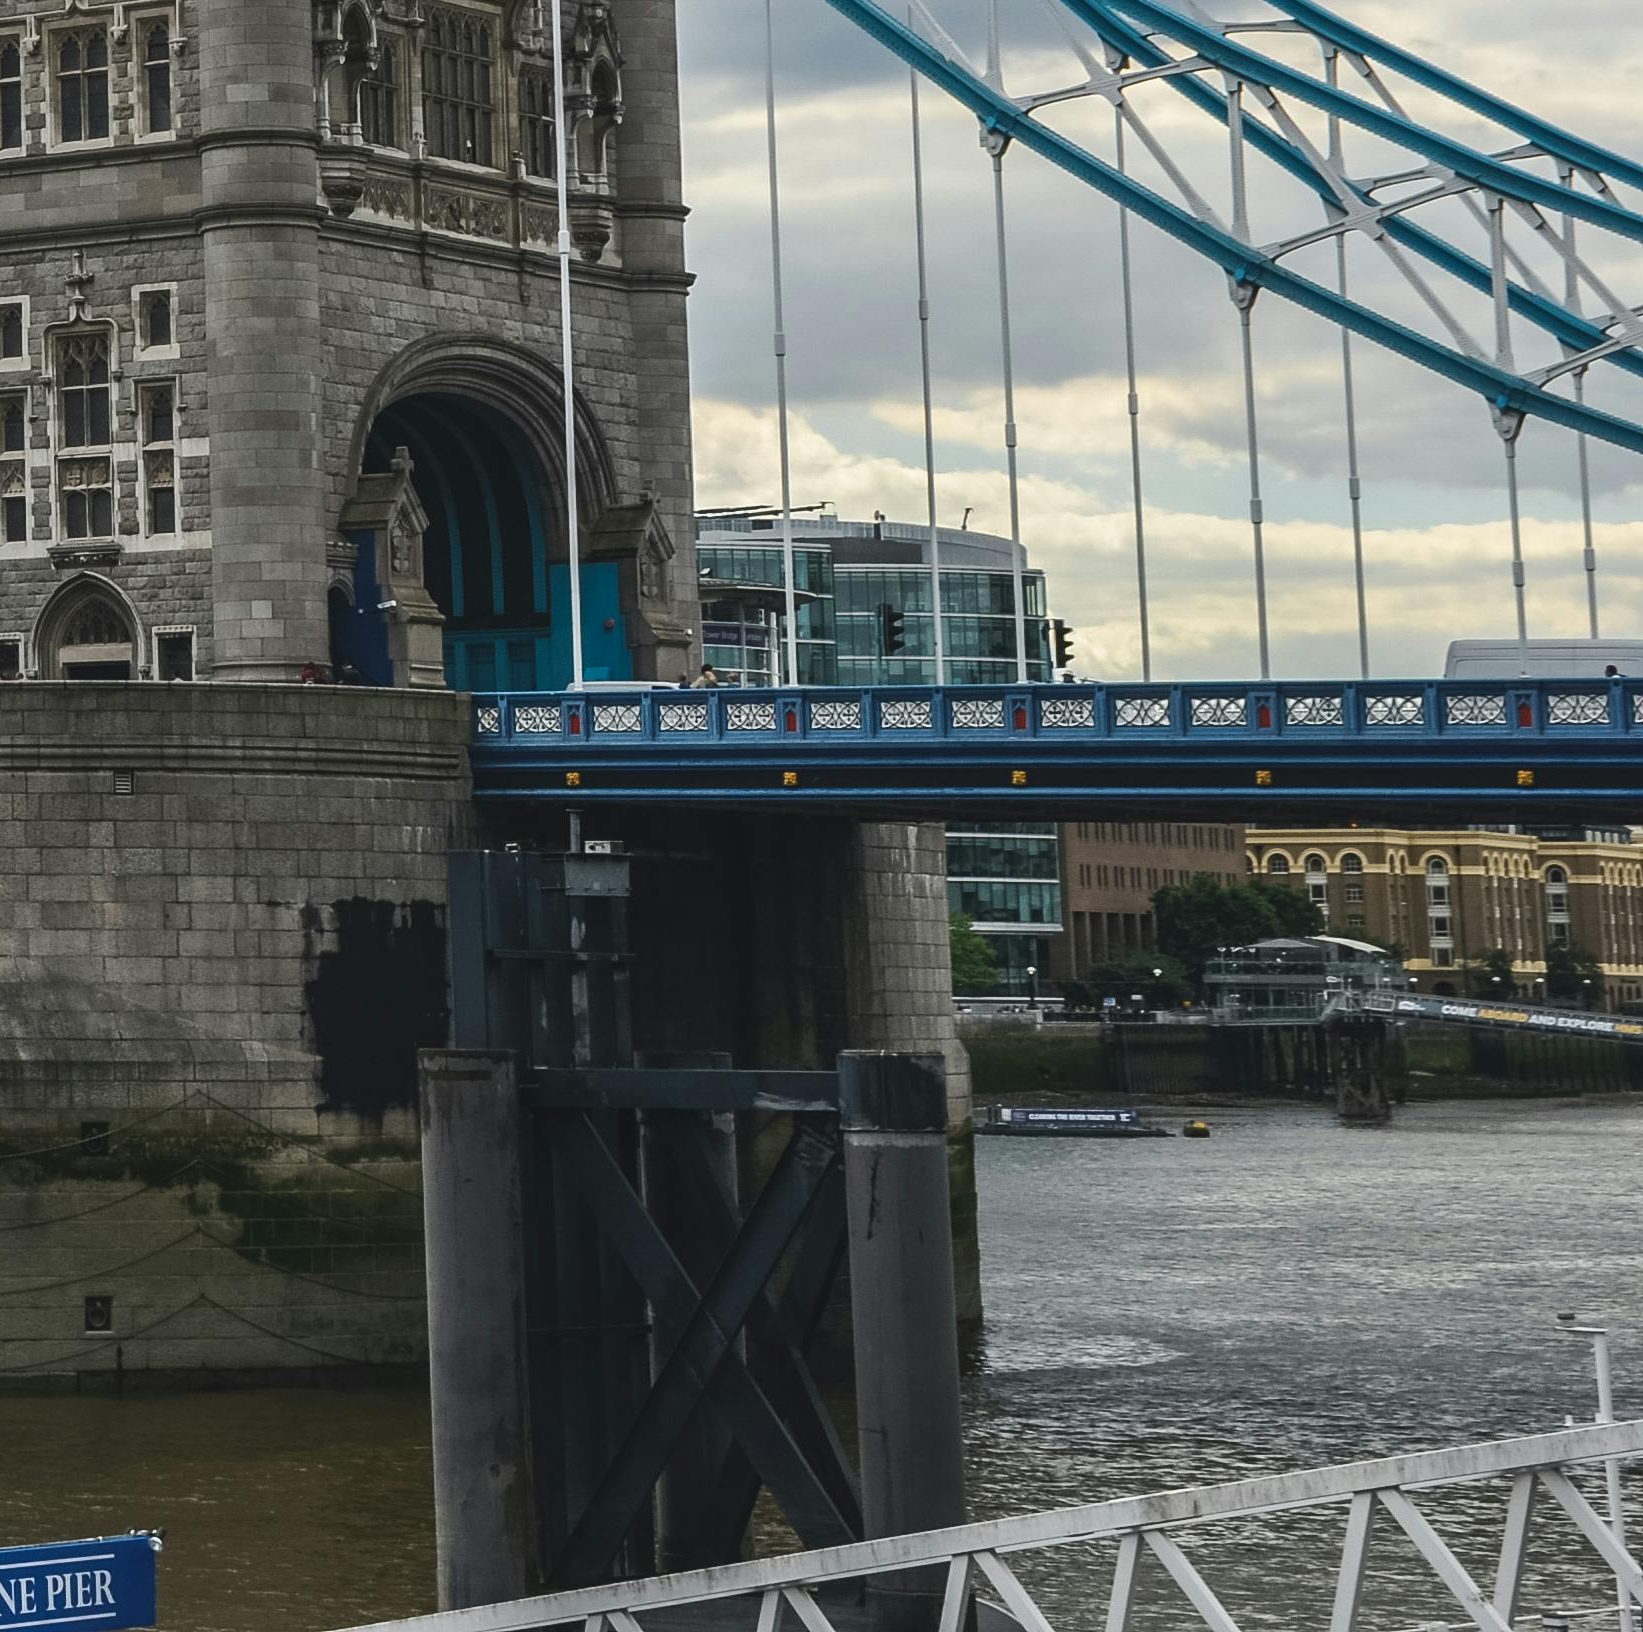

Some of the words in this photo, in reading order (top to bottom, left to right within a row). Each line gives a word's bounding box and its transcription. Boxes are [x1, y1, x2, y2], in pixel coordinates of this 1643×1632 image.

[1441, 1004, 1478, 1017] COME
[1528, 1014, 1556, 1025] AND
[1556, 1018, 1614, 1032] EXPLORE
[44, 1569, 116, 1612] PIER
